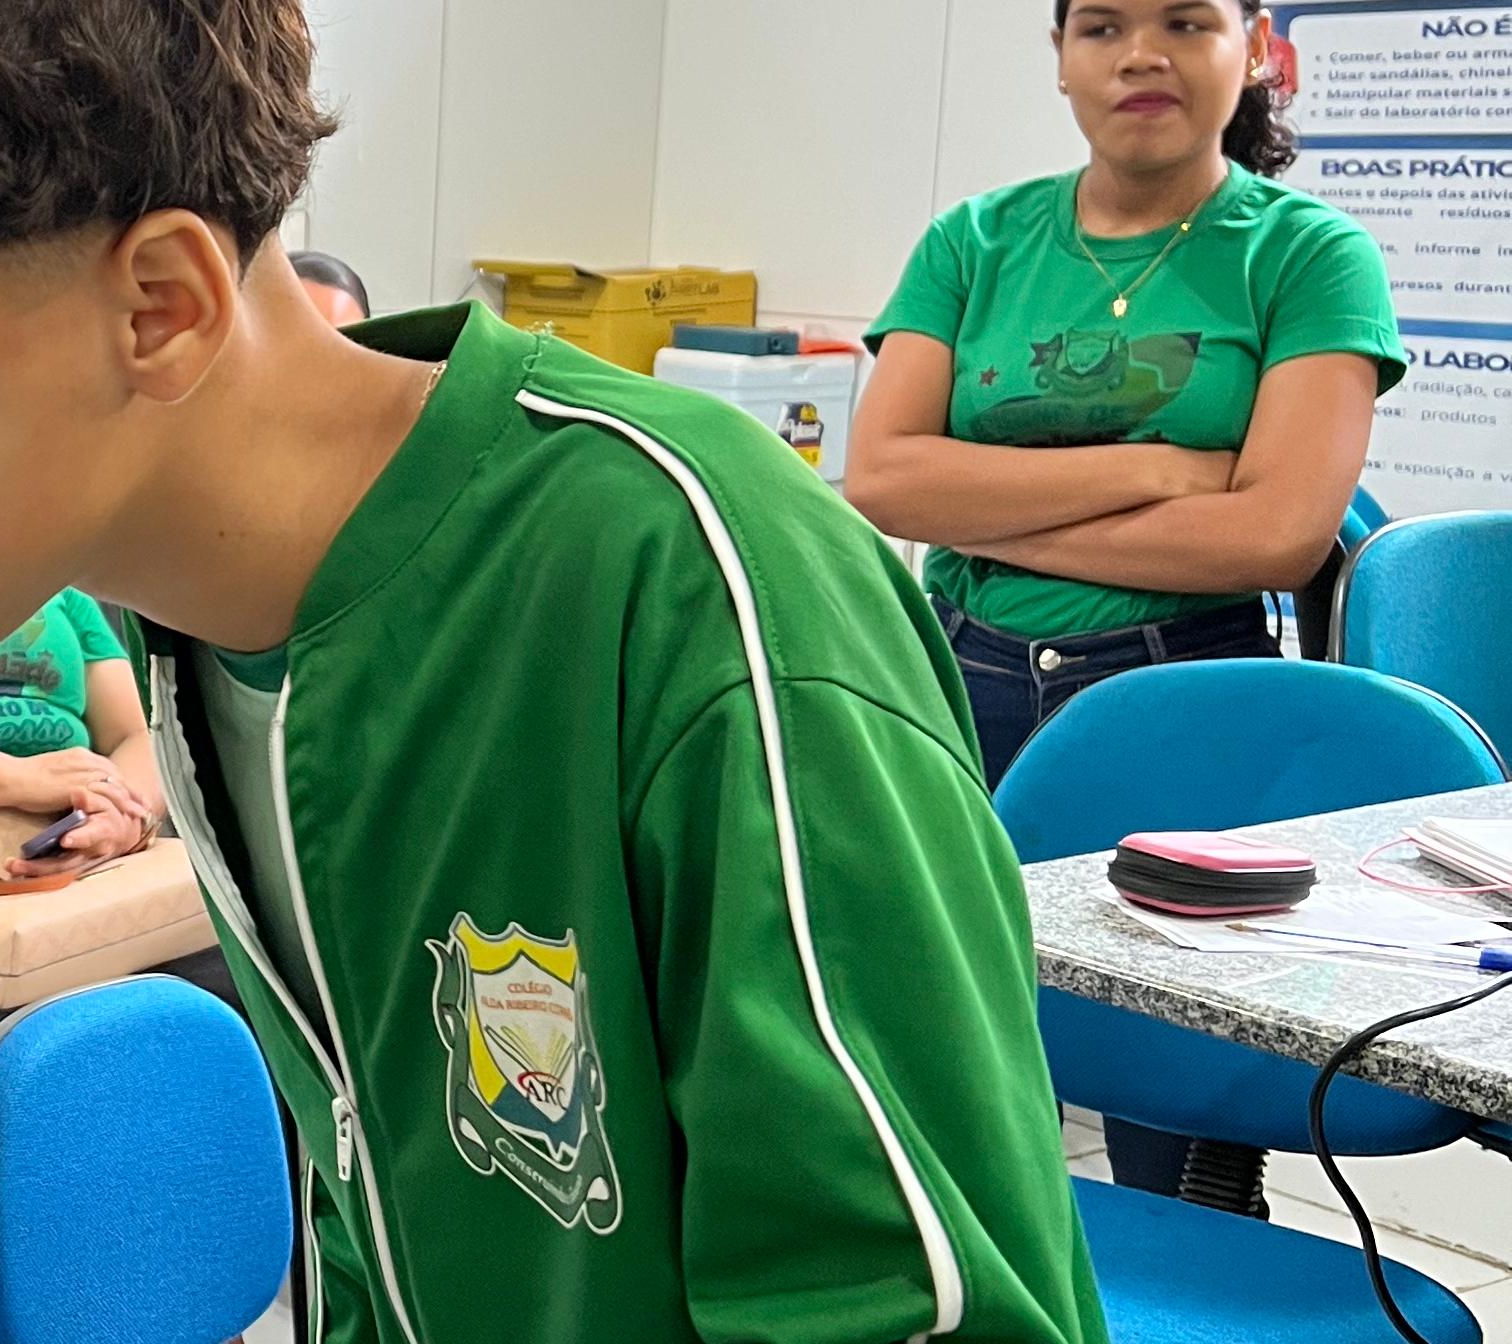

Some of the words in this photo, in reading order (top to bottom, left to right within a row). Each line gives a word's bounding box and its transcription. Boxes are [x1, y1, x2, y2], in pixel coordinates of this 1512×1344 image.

[1422, 16, 1488, 38] NÃO
[1392, 49, 1441, 61] beber
[1445, 50, 1467, 60] ou
[1328, 70, 1363, 81] Usar
[1326, 88, 1410, 102] Manipular
[1416, 86, 1497, 98] materiais
[1325, 106, 1354, 117] Sair
[1360, 106, 1380, 117] do
[1385, 104, 1481, 118] laboratório
[1321, 159, 1402, 177] BOAS
[1409, 155, 1512, 178] PRÁTIC
[1366, 189, 1375, 197] e
[1380, 187, 1433, 200] depois
[1438, 188, 1466, 199] das
[1415, 242, 1481, 255] informe
[1424, 349, 1512, 371] LABO
[1421, 408, 1497, 426] produtos
[1394, 462, 1475, 481] exposição
